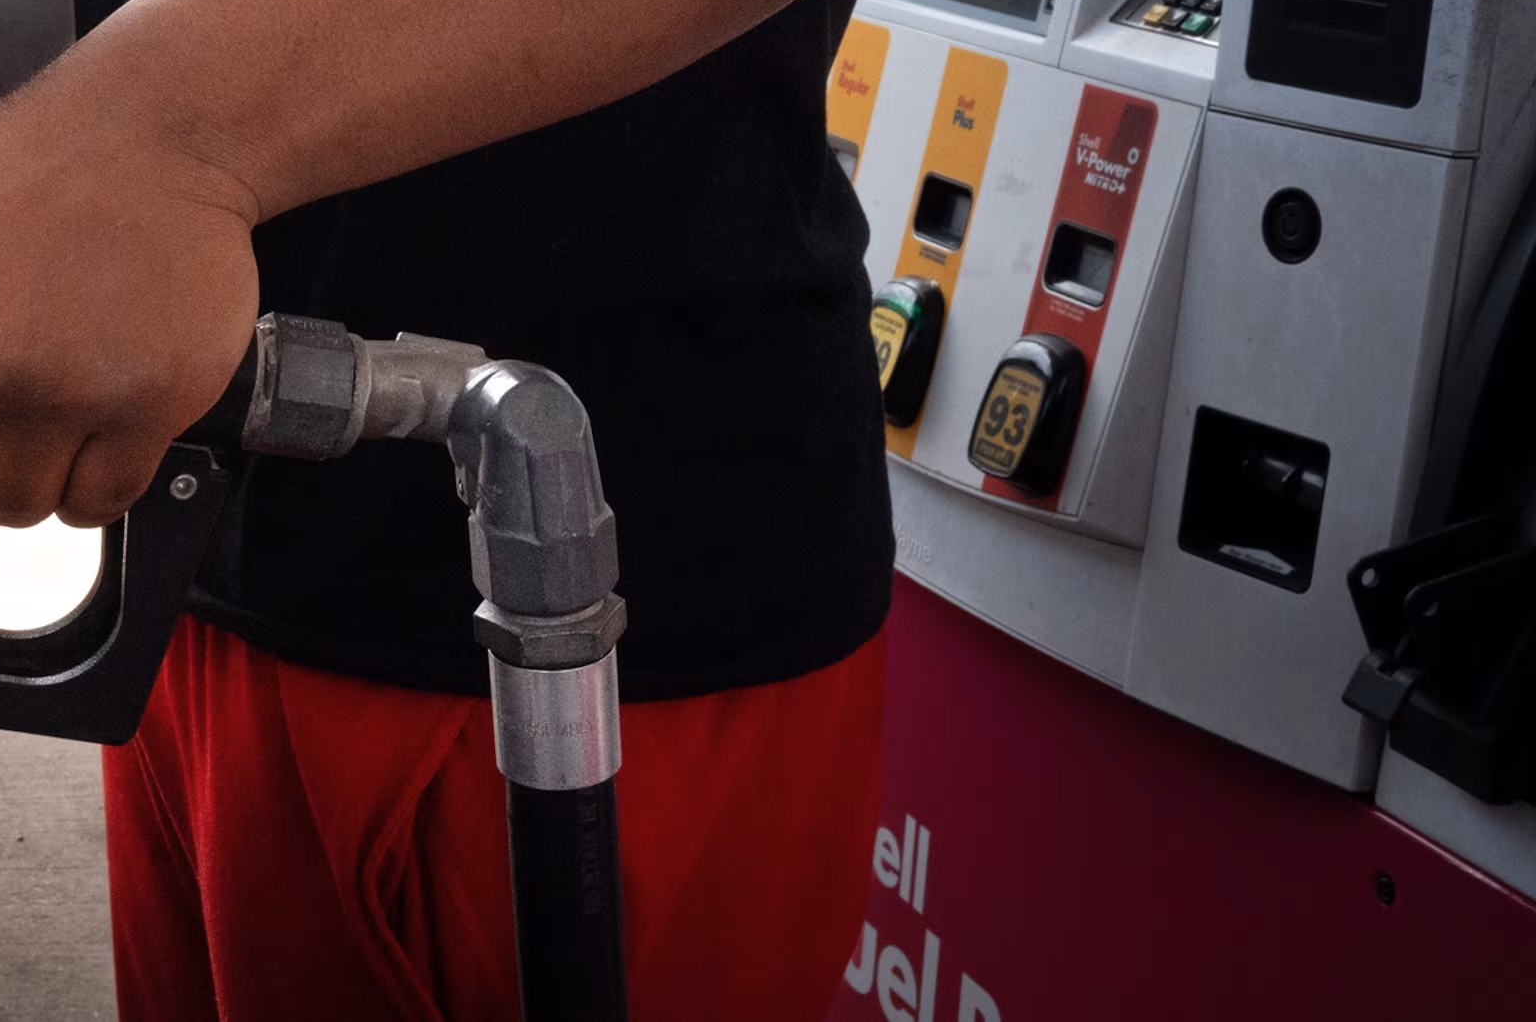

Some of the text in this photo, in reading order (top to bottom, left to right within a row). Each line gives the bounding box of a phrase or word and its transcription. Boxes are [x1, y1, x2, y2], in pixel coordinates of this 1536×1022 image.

[838, 72, 871, 96] Regular
[957, 95, 976, 110] Shell
[952, 109, 976, 130] Plus
[1079, 133, 1101, 149] Shell
[1076, 147, 1131, 180] V-Power
[984, 394, 1031, 446] 93
